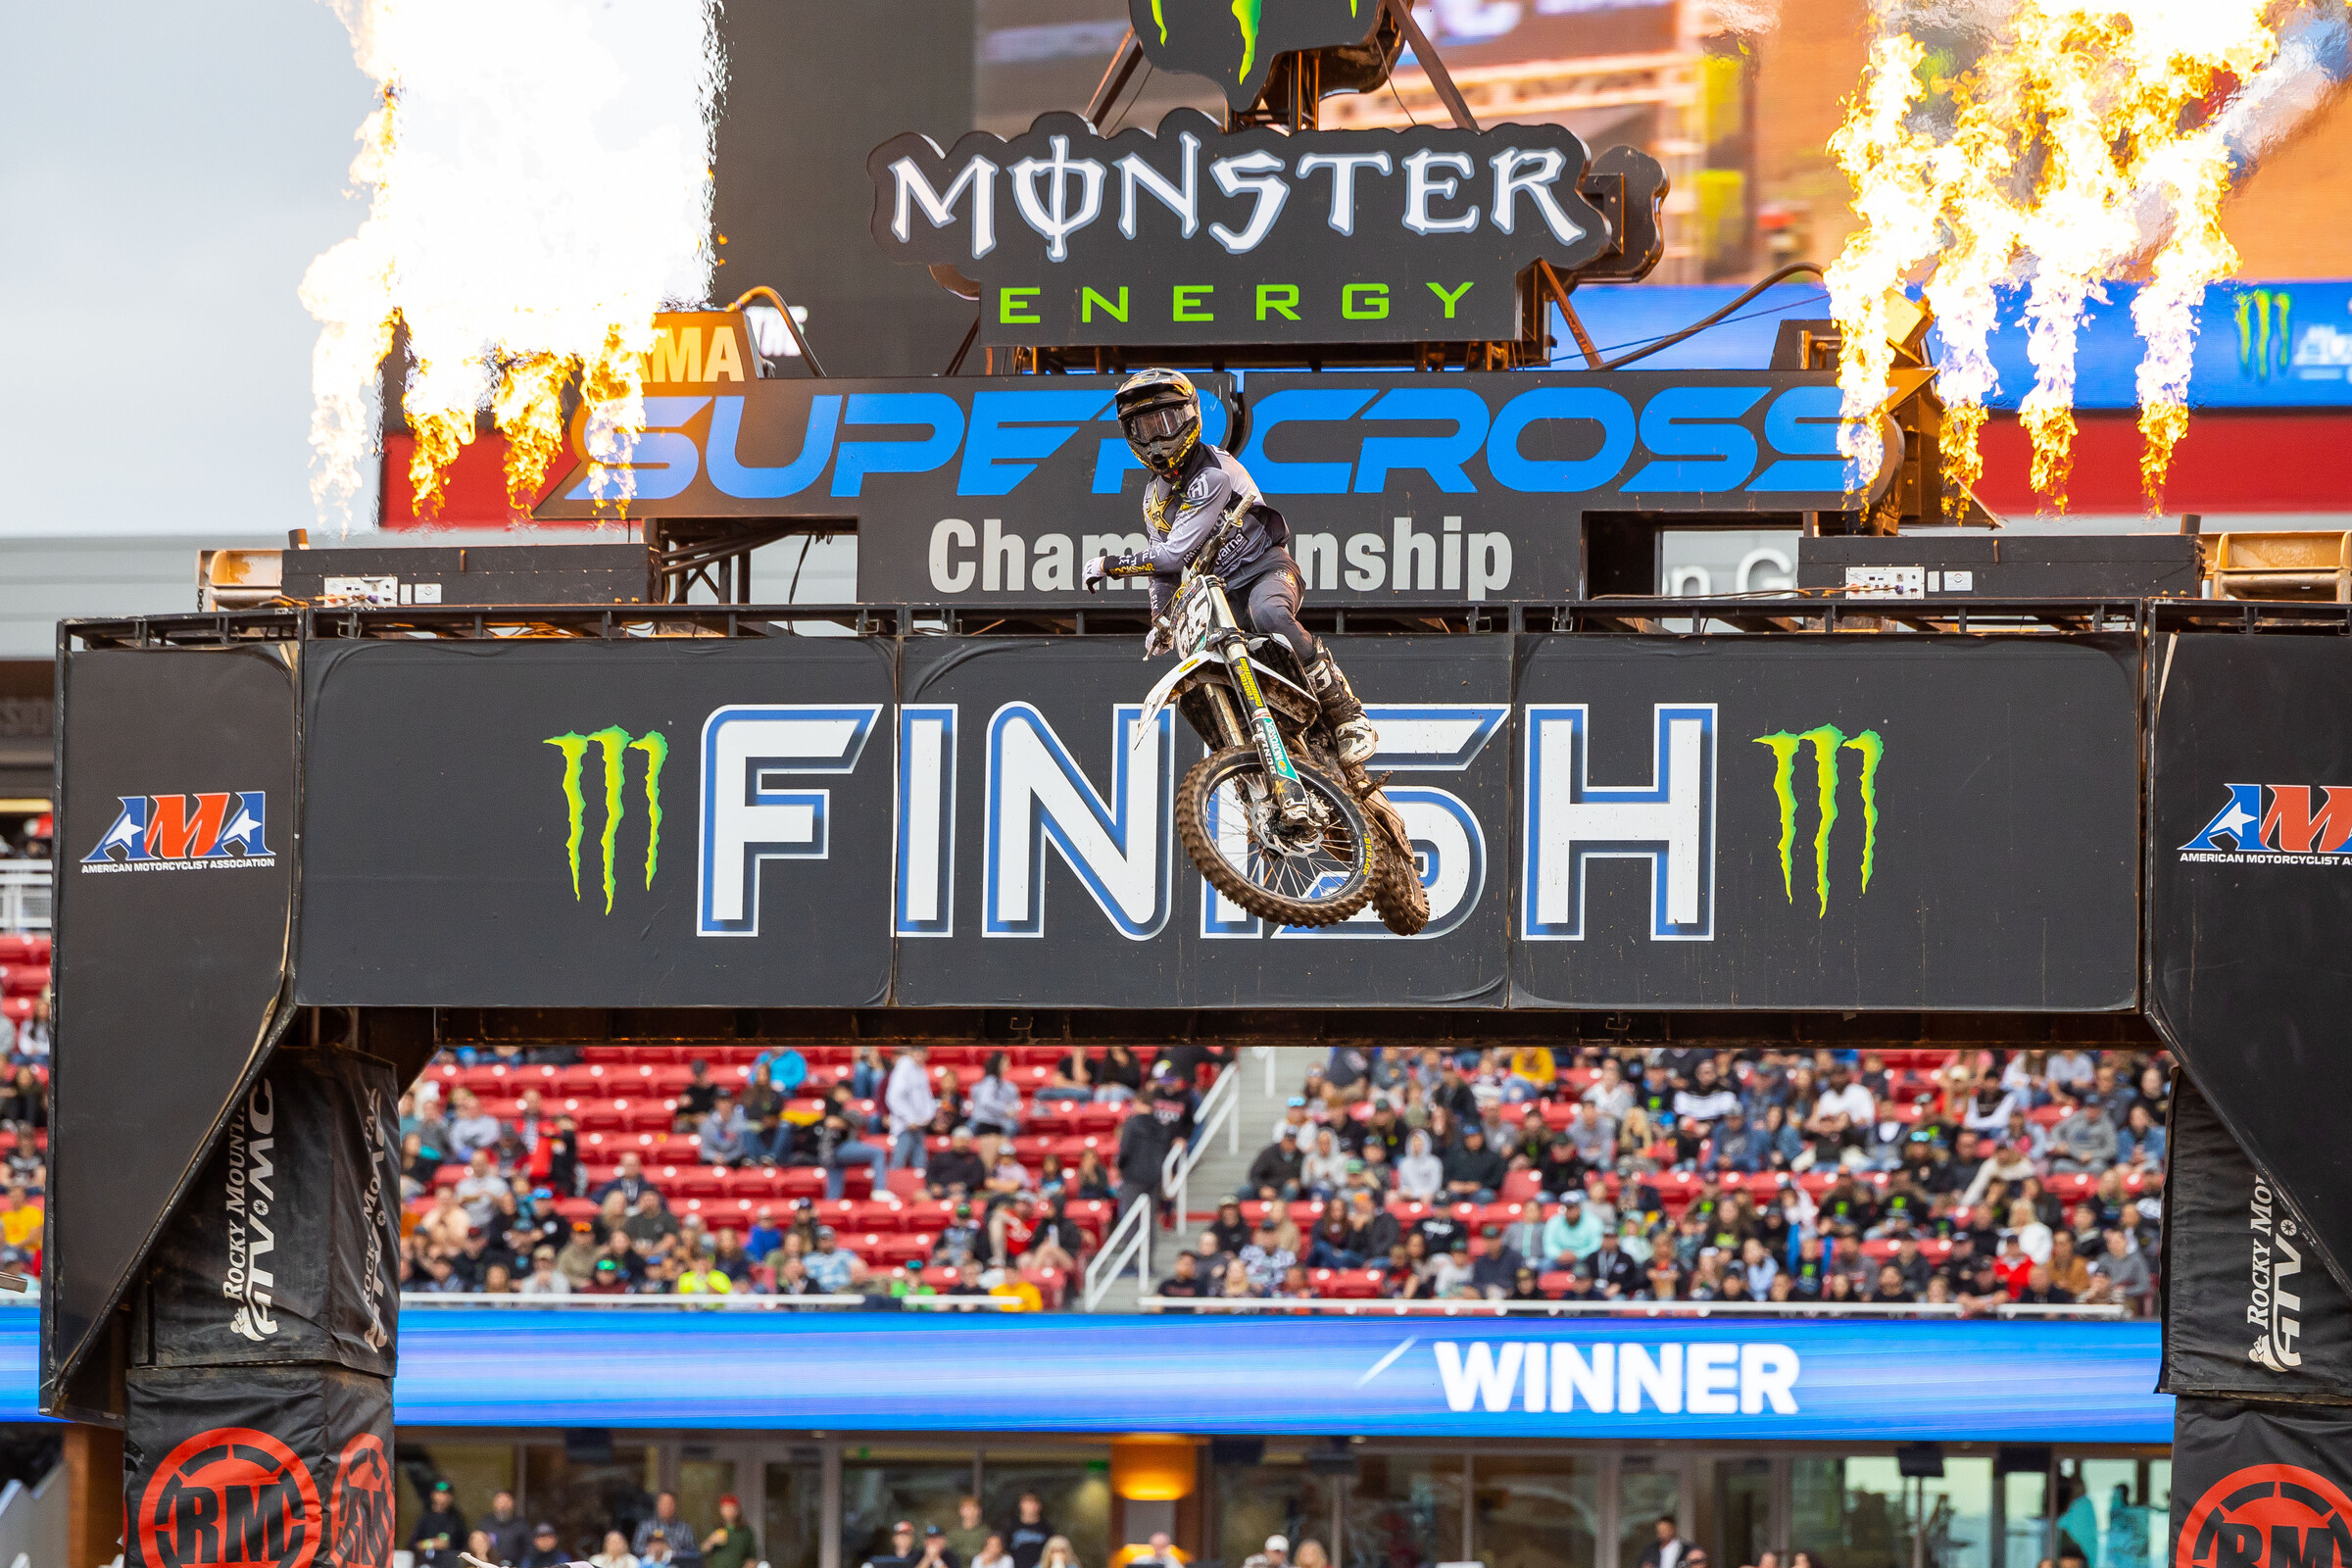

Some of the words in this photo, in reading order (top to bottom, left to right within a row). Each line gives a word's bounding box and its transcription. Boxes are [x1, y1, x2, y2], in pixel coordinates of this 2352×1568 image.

[889, 133, 1587, 263] MONSTER
[1000, 281, 1474, 324] ENERGY
[929, 516, 1513, 602] Chamnship
[1142, 545, 1162, 562] FLY
[1265, 720, 1285, 761] MOTOREX
[80, 790, 277, 863] AMA
[2177, 783, 2352, 855] AM
[81, 862, 133, 874] AMERICAN
[134, 860, 208, 872] MOTORCYCLIST
[210, 858, 275, 869] ASSOCIATION
[1362, 837, 1372, 875] DUNLOP
[2180, 853, 2240, 863] AMERICAN
[2246, 855, 2340, 866] MOTORCYCLIST
[1434, 1341, 1800, 1414] WINNER
